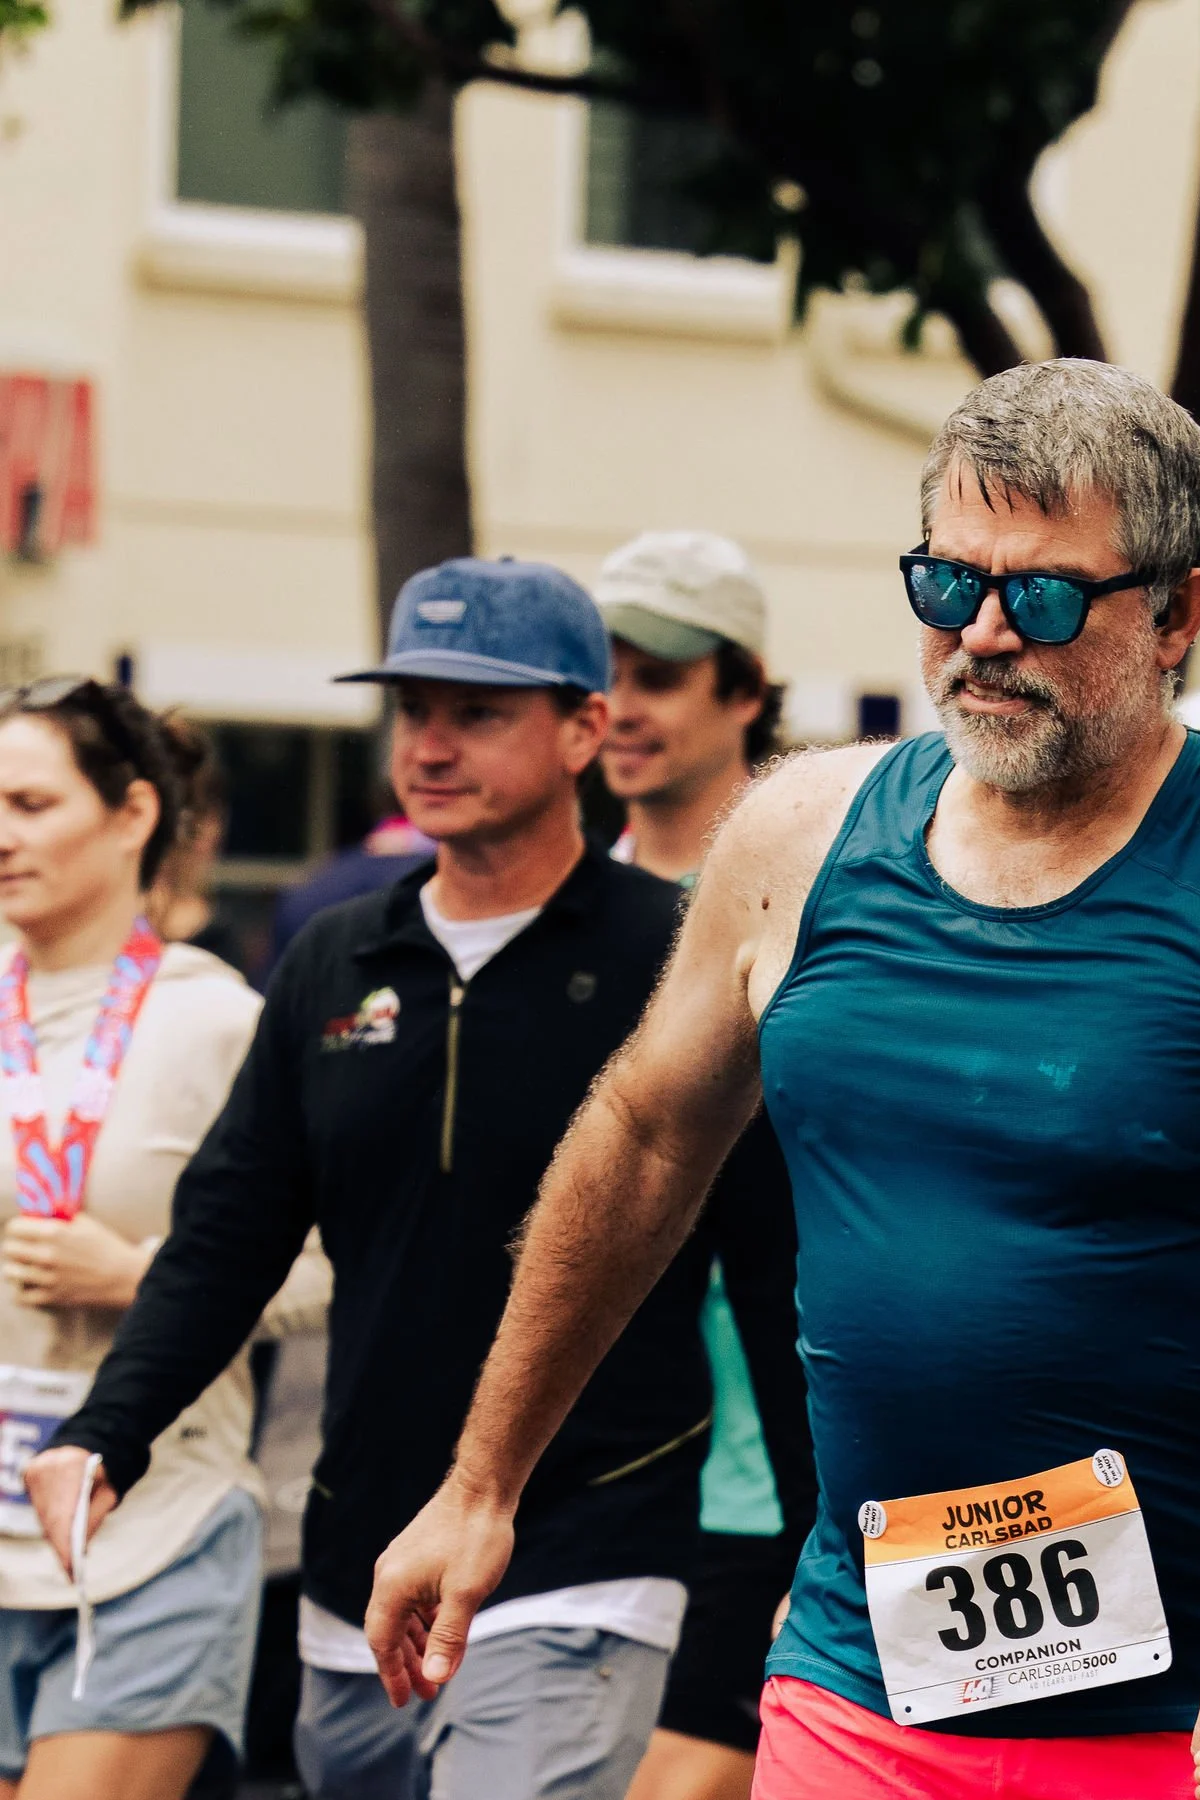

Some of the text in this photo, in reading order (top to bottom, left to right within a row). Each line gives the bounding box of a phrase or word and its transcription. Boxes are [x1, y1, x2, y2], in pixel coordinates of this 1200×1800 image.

[942, 1489, 1047, 1531] JUNIOR
[945, 1516, 1053, 1550] CARLSBAD
[925, 1539, 1100, 1652] 386
[975, 1638, 1082, 1671] COMPANION
[1008, 1652, 1117, 1685] CARLSBAD5000
[1081, 1669, 1099, 1679] FAST
